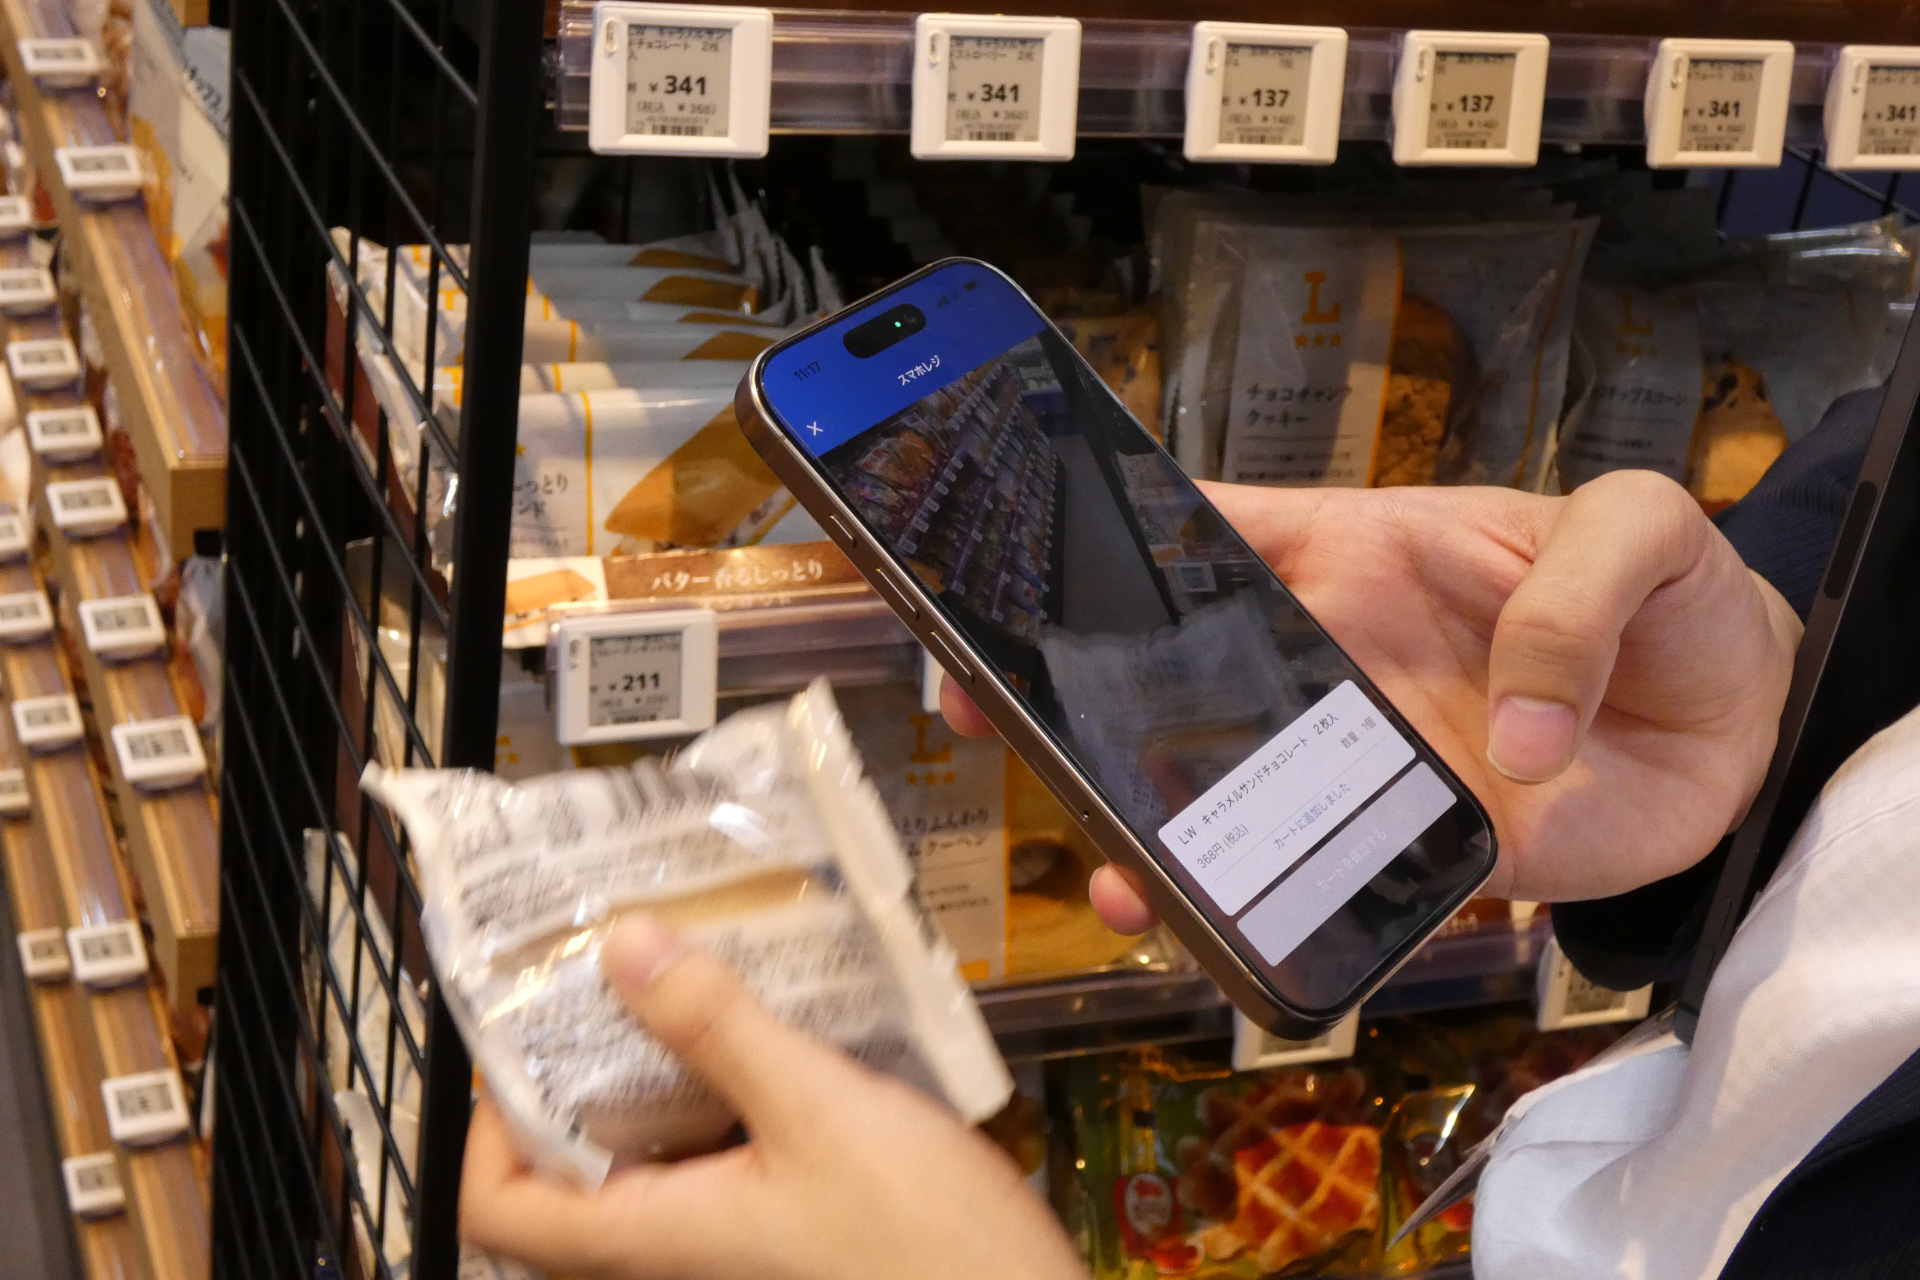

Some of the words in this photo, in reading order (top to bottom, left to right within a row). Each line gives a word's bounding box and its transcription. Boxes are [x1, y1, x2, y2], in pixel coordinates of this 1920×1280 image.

[1302, 271, 1341, 324] L
[793, 361, 822, 382] 11:17
[897, 354, 941, 386] スマホレジ
[623, 672, 661, 692] 211
[909, 713, 951, 764] L
[1177, 825, 1198, 846] LW
[1201, 735, 1309, 827] キャラメルサンドチョコレート
[1312, 712, 1340, 736] 2枚入
[1273, 781, 1351, 850] カートに追加しました
